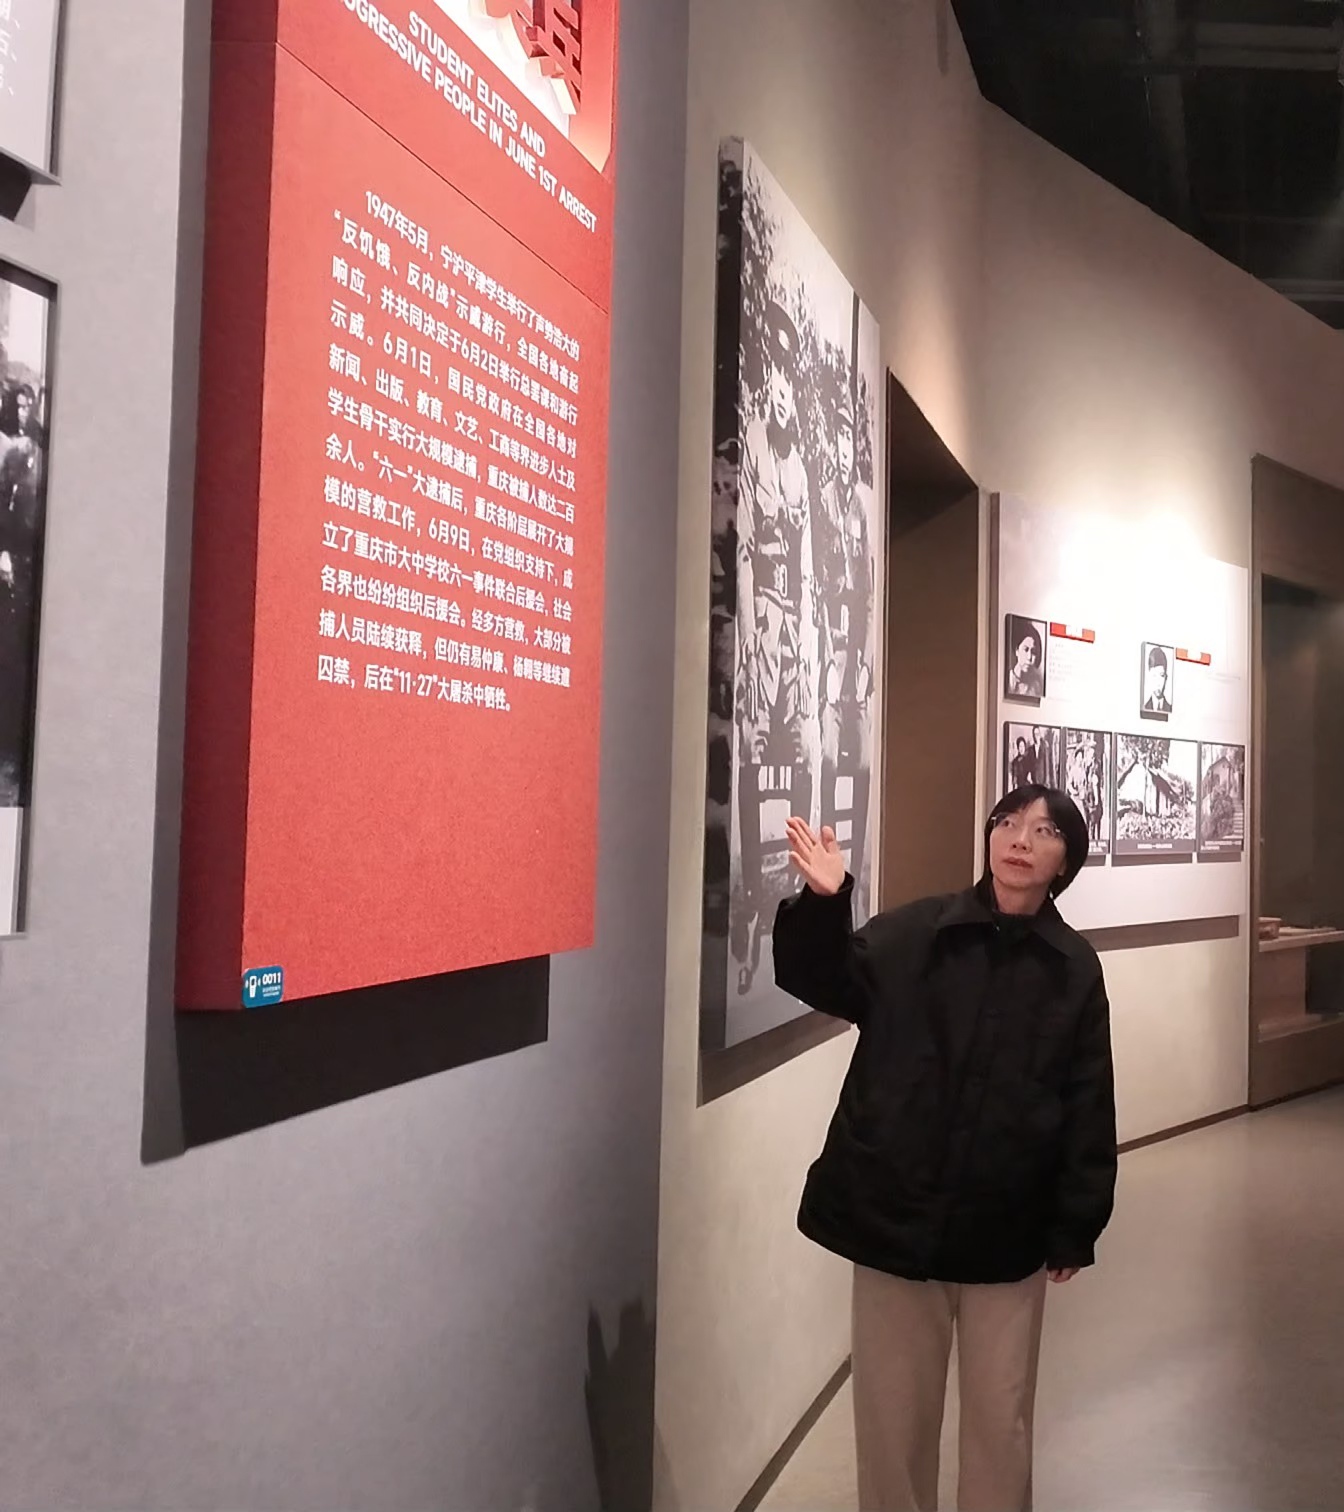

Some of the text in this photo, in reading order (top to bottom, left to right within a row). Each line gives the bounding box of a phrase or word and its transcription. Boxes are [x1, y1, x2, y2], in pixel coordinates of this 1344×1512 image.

[409, 11, 474, 89] STUDENT
[477, 76, 518, 132] ELITES
[520, 121, 546, 158] AND
[435, 67, 486, 134] PEOPLE
[489, 122, 503, 149] IN
[505, 135, 536, 179] JUNE
[538, 166, 557, 197] 1ST
[559, 185, 597, 233] ARREST
[262, 972, 281, 985] 0011
